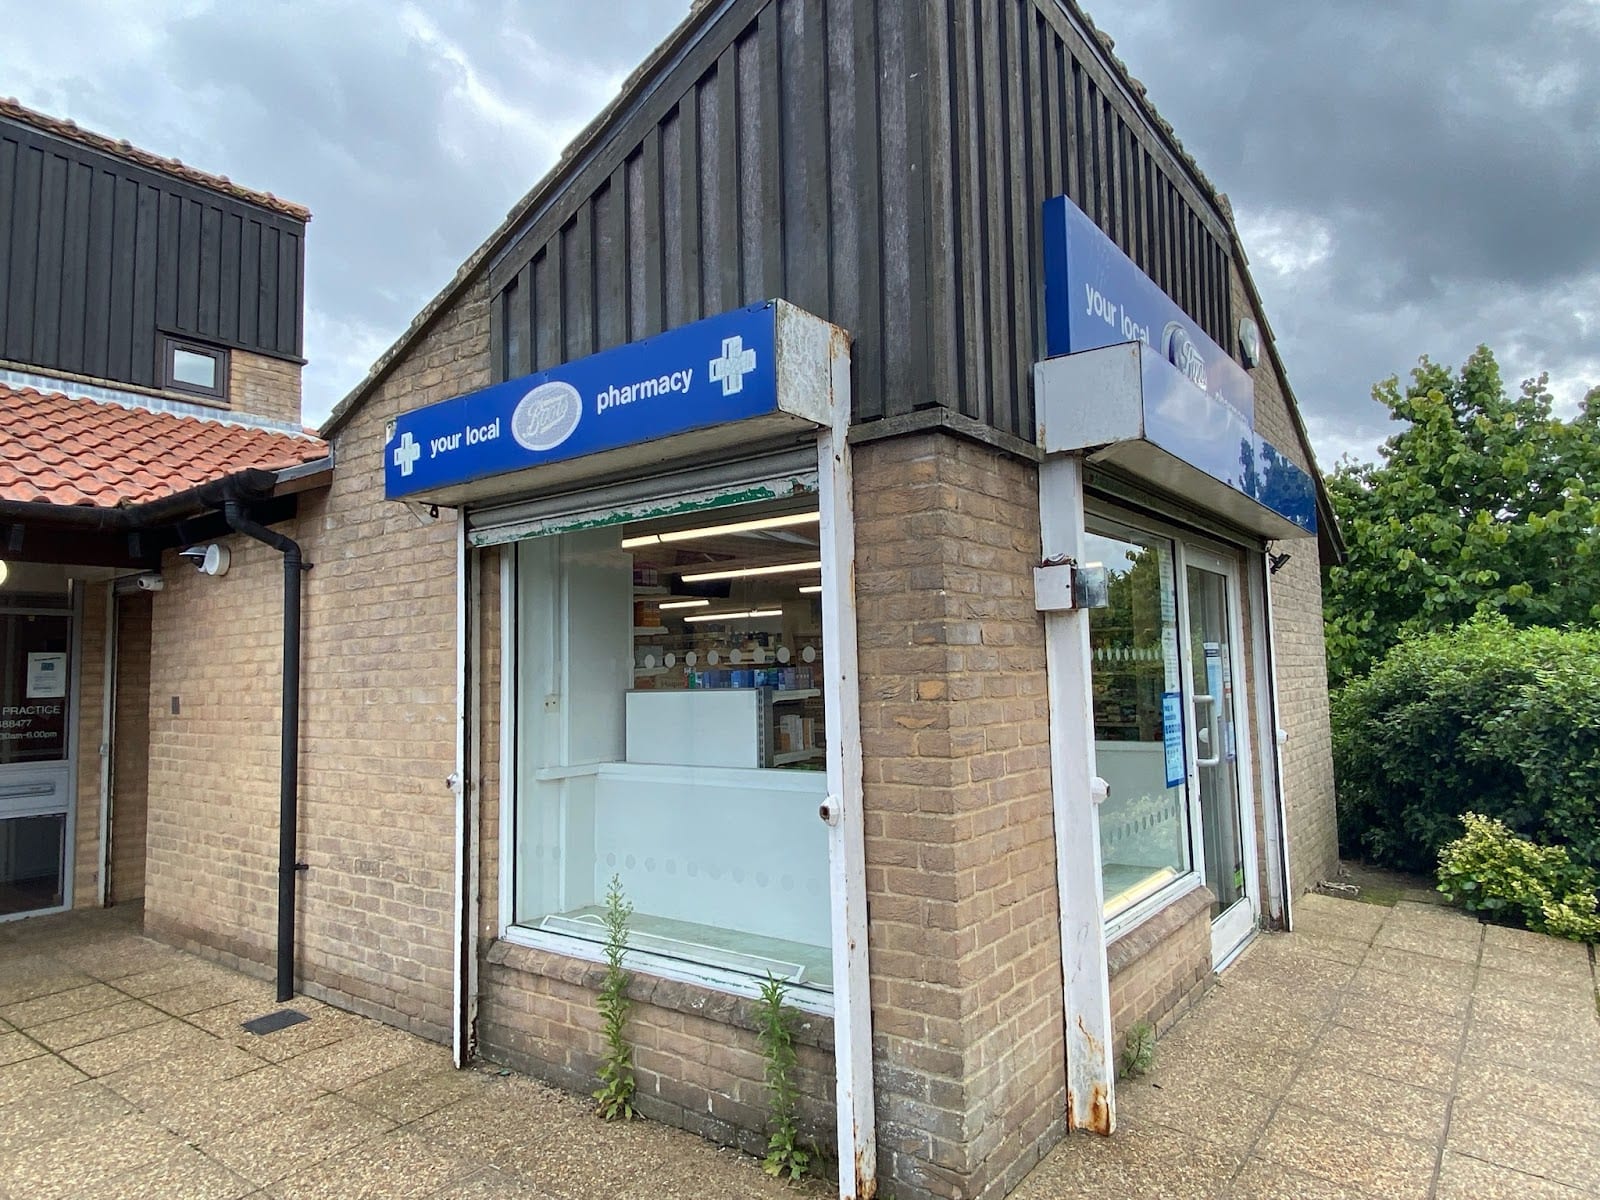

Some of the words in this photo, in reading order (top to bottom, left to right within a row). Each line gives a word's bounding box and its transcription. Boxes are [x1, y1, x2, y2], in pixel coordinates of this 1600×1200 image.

[1086, 283, 1117, 328] your
[1120, 304, 1150, 345] local
[430, 432, 462, 459] your
[466, 417, 500, 446] local
[597, 368, 693, 415] pharmacy
[2, 705, 61, 715] PRACTICE
